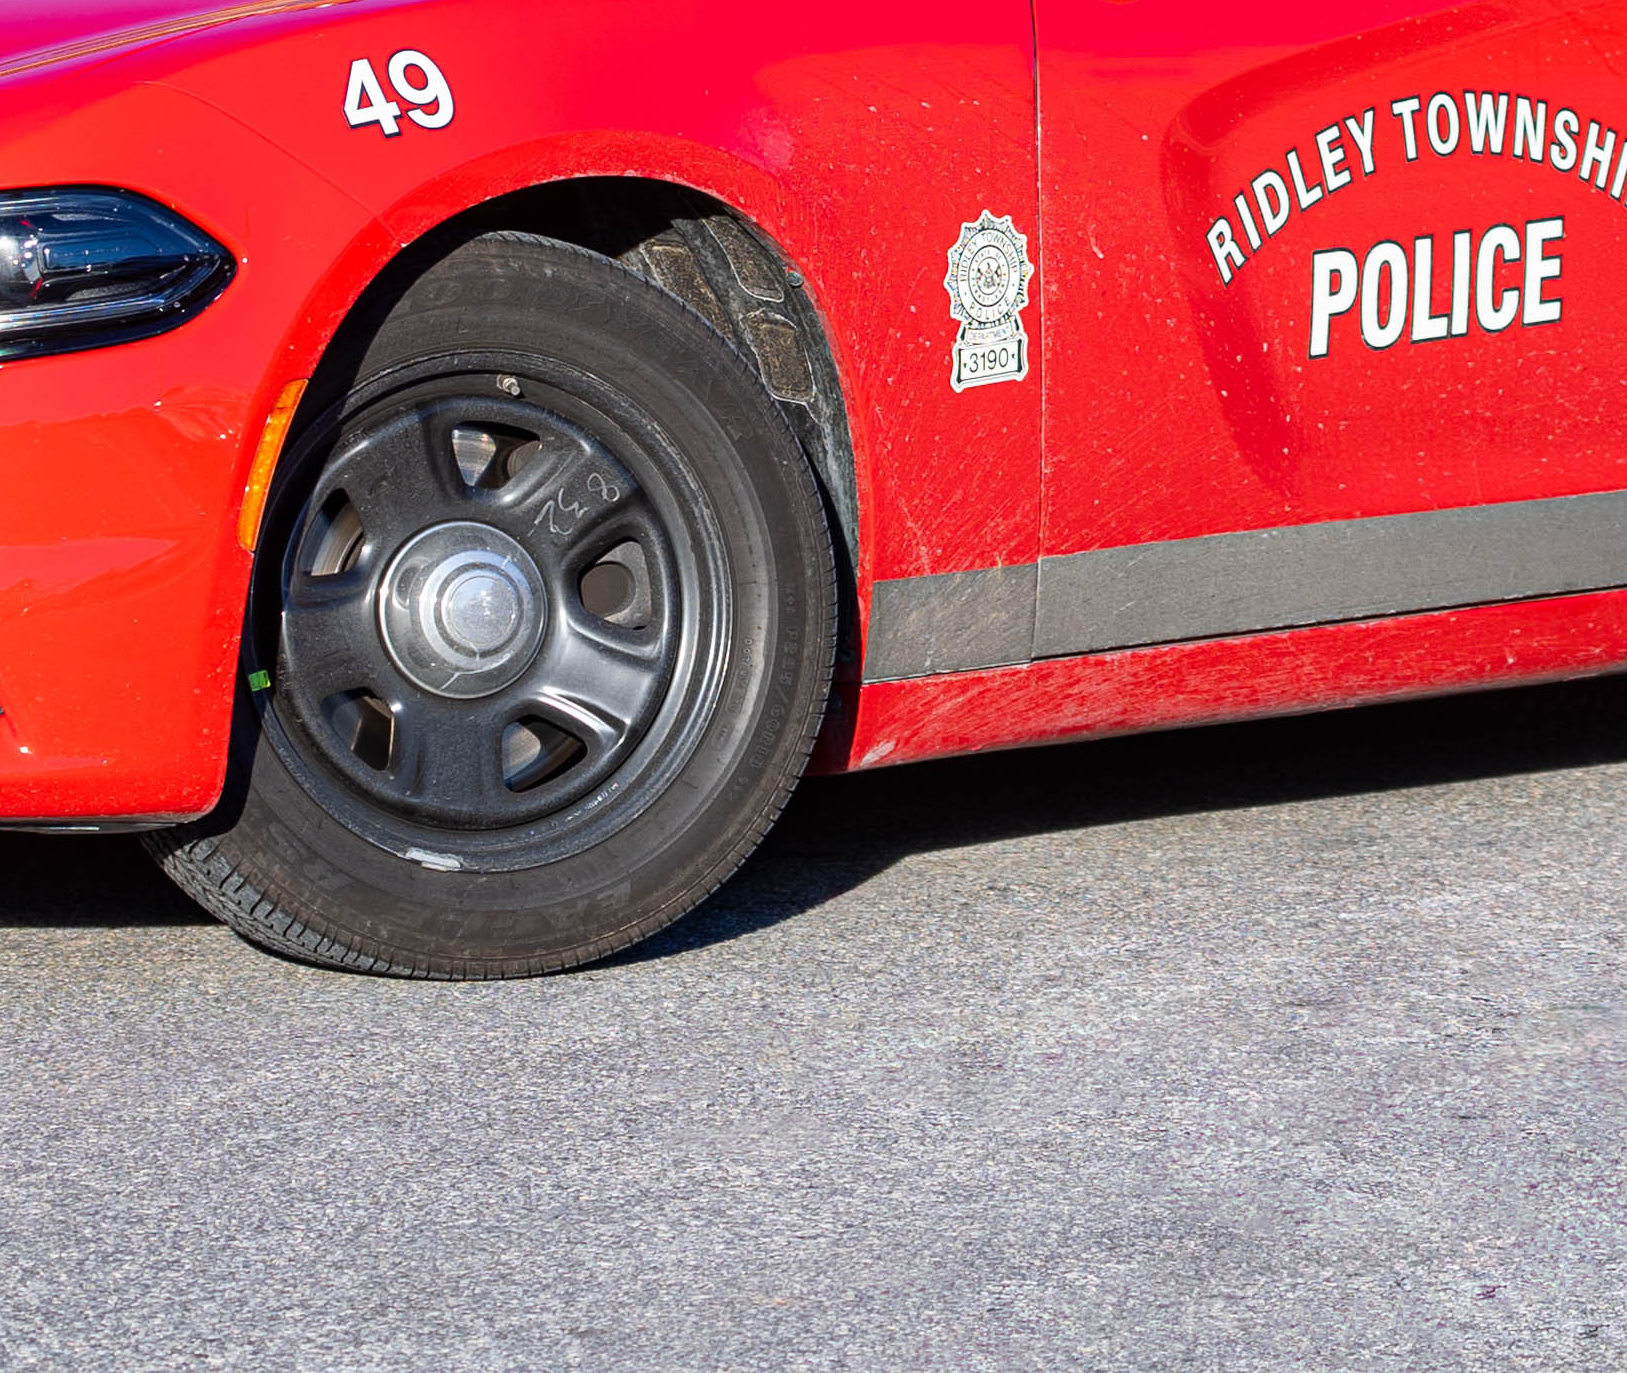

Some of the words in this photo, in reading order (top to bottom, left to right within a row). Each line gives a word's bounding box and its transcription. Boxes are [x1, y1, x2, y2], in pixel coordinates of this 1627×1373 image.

[342, 48, 455, 139] 49
[1205, 106, 1375, 287] RIDLEY
[959, 238, 977, 282] RIDLEY
[981, 231, 1018, 273] TOWNSHIP
[1308, 216, 1565, 360] POLICE
[969, 297, 1011, 320] POLICE
[969, 347, 1009, 373] 3190
